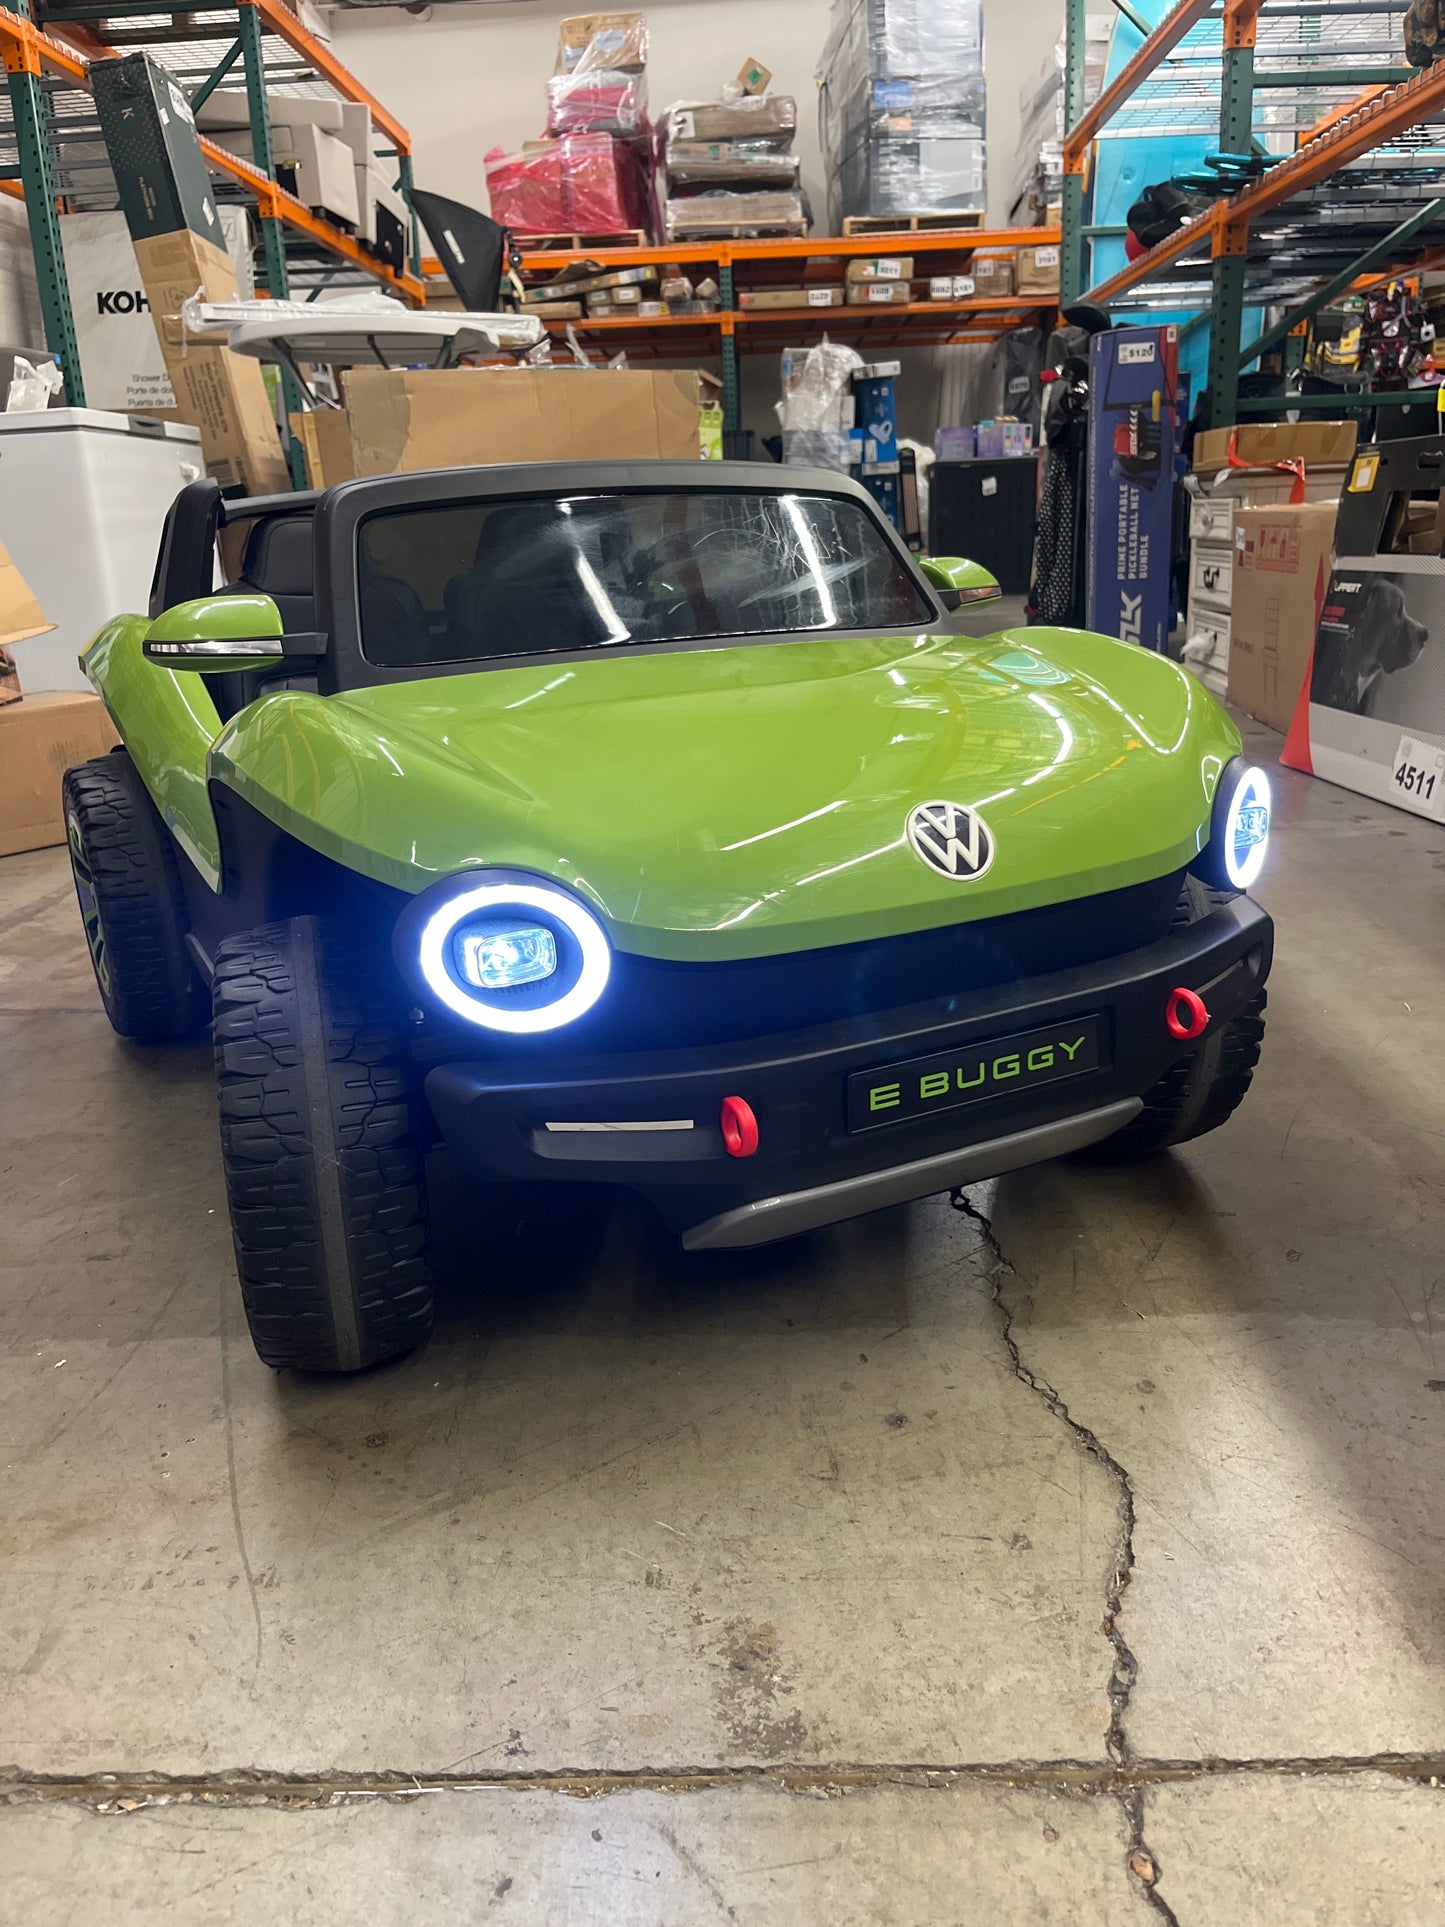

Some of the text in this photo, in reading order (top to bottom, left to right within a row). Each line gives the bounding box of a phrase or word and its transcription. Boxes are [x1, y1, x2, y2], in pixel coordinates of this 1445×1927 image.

[1117, 484, 1129, 580] PRIME PORTABLE
[1128, 488, 1140, 580] PICKLEBALL NET
[1139, 533, 1149, 579] BUNDLE
[1395, 762, 1436, 800] 4511
[869, 1036, 1086, 1111] E BUGGY
